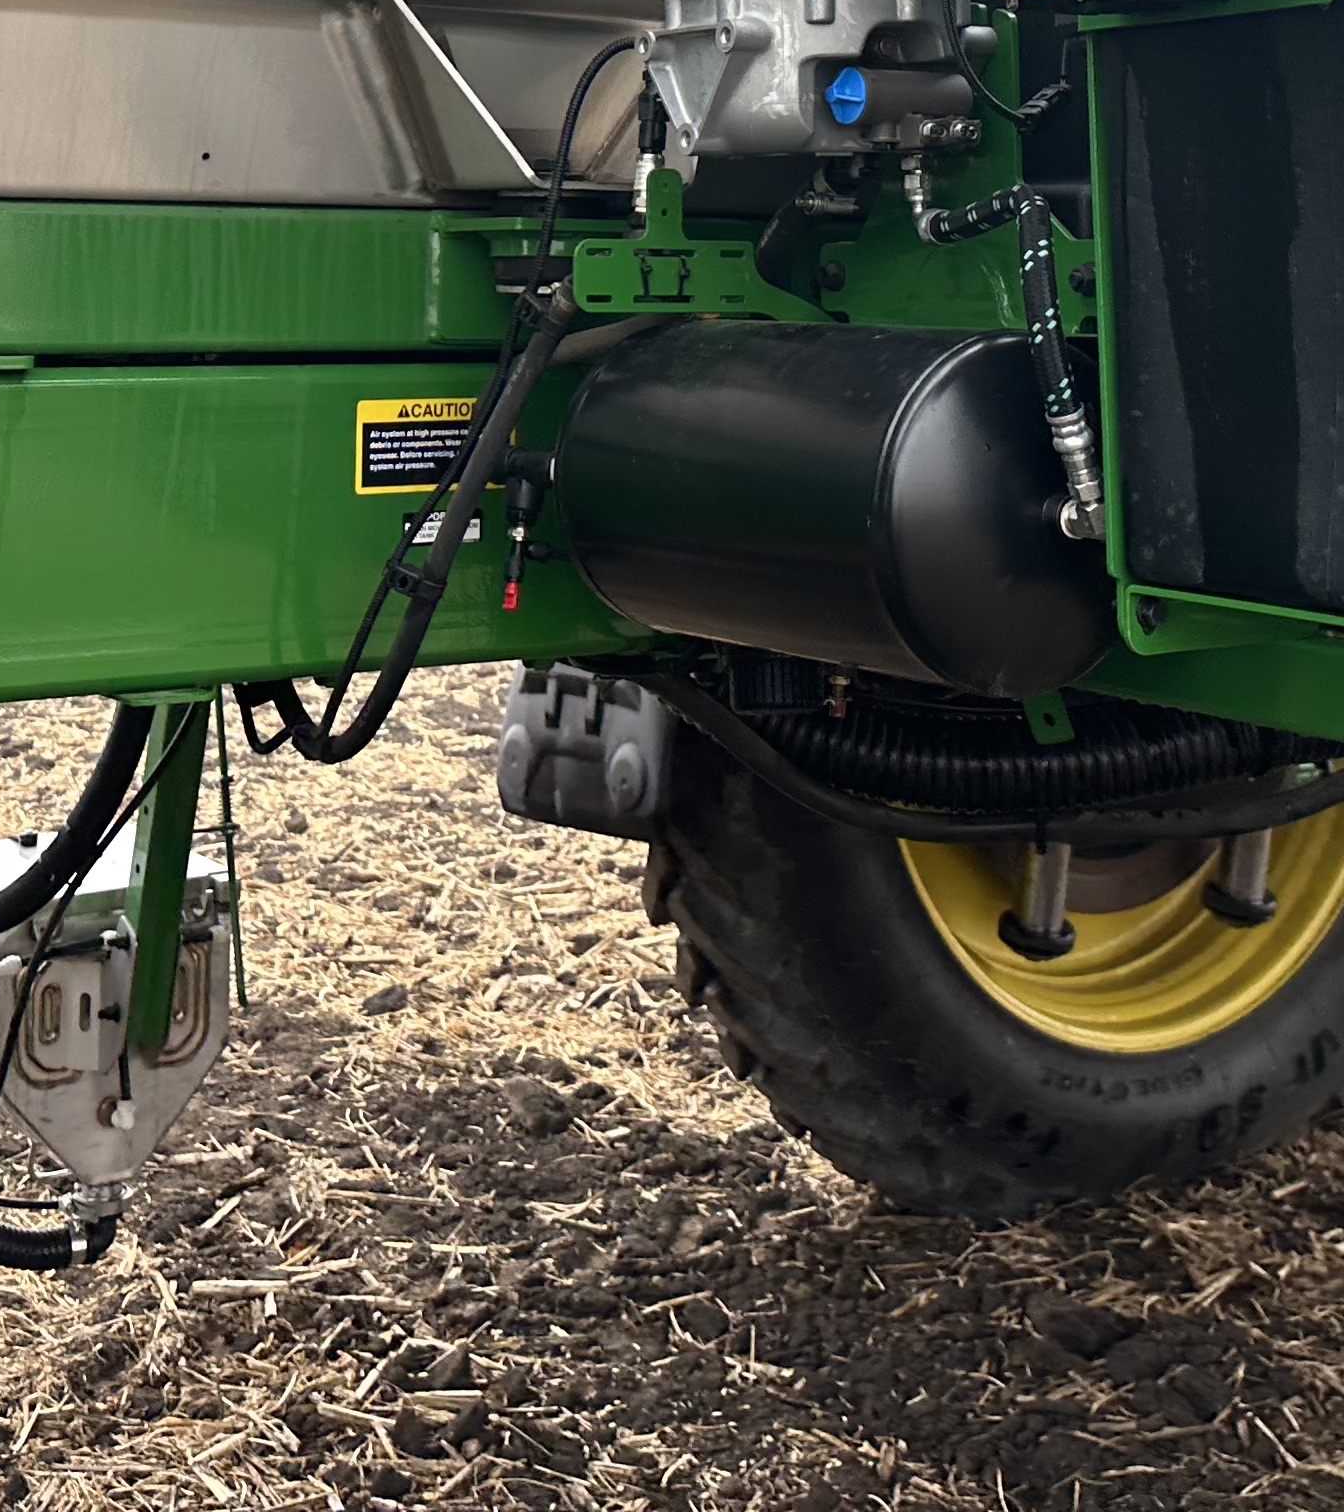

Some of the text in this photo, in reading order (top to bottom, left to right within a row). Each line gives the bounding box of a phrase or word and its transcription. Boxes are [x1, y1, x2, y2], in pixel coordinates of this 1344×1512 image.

[411, 402, 471, 418] CAUTIO
[370, 430, 380, 438] Air
[381, 430, 406, 439] system
[414, 429, 430, 438] high
[430, 429, 459, 438] pressure
[369, 441, 392, 449] debris
[400, 451, 423, 459] Before
[369, 463, 394, 472] system
